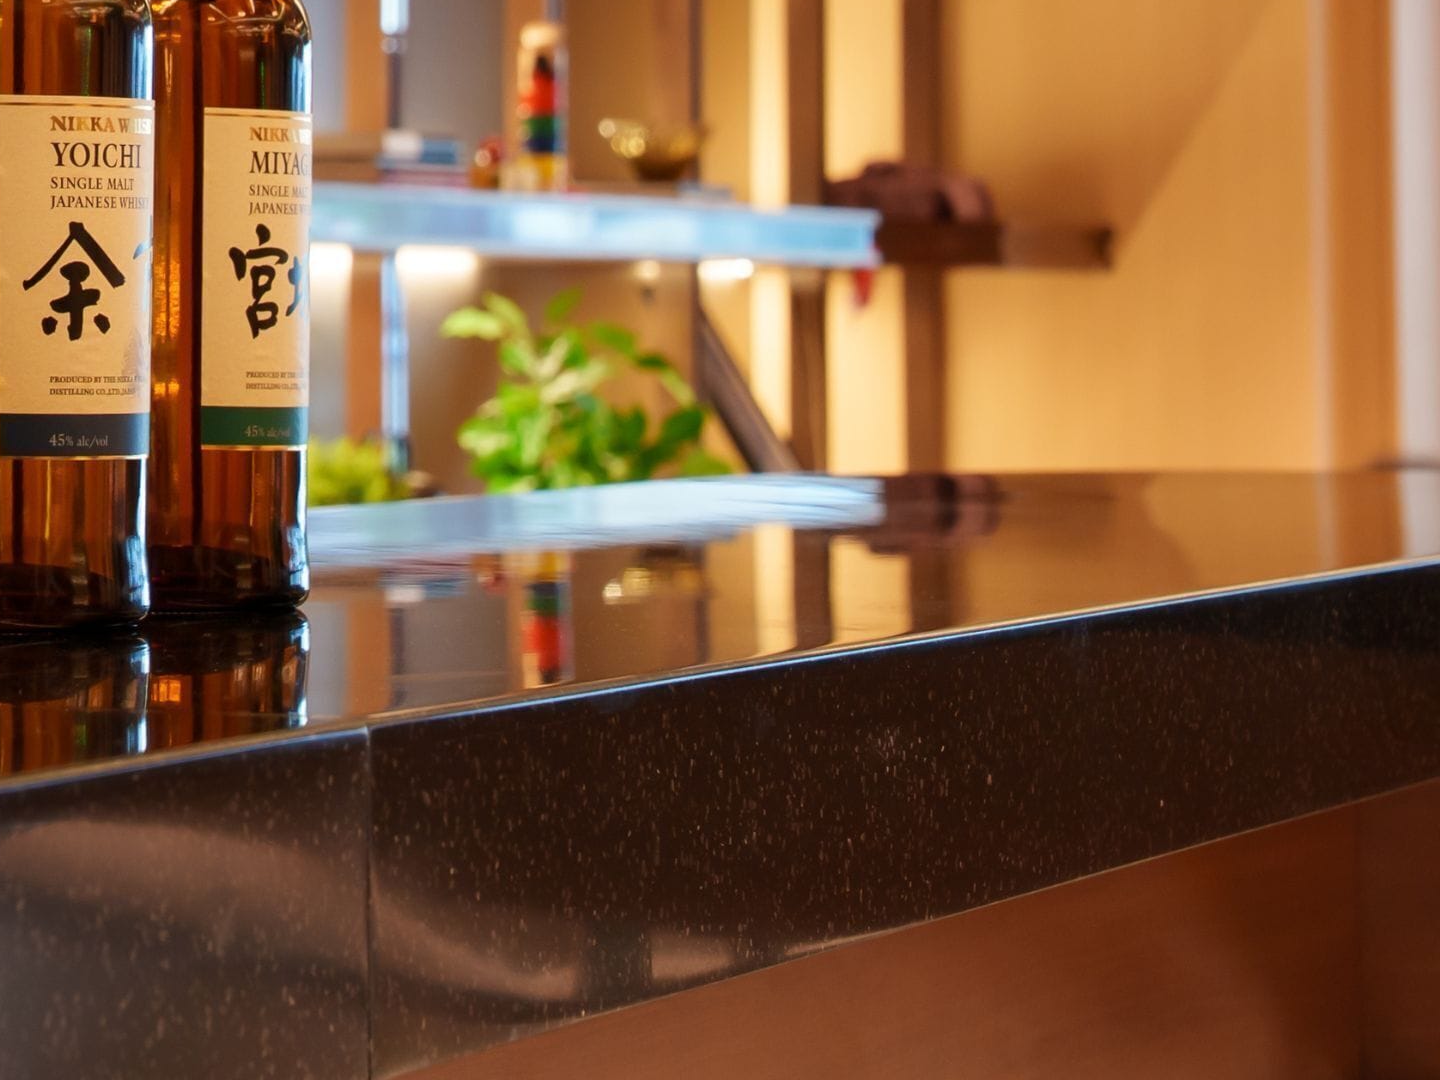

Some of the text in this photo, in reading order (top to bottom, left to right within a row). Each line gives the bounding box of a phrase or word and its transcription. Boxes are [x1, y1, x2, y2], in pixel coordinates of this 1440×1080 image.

[50, 115, 116, 133] NIKKA
[249, 126, 299, 142] NIKK
[50, 141, 142, 169] YOICHI
[50, 176, 134, 191] SINGLE MALT
[248, 184, 289, 197] SINGLE
[49, 195, 117, 210] JAPANESE
[248, 201, 298, 216] JAPANESE
[22, 221, 150, 341] 余
[228, 223, 302, 339] 宮
[49, 376, 93, 384] PRODUCED
[94, 376, 102, 384] BY
[49, 388, 95, 396] DISTILLING
[49, 433, 109, 448] 45% alc/vol
